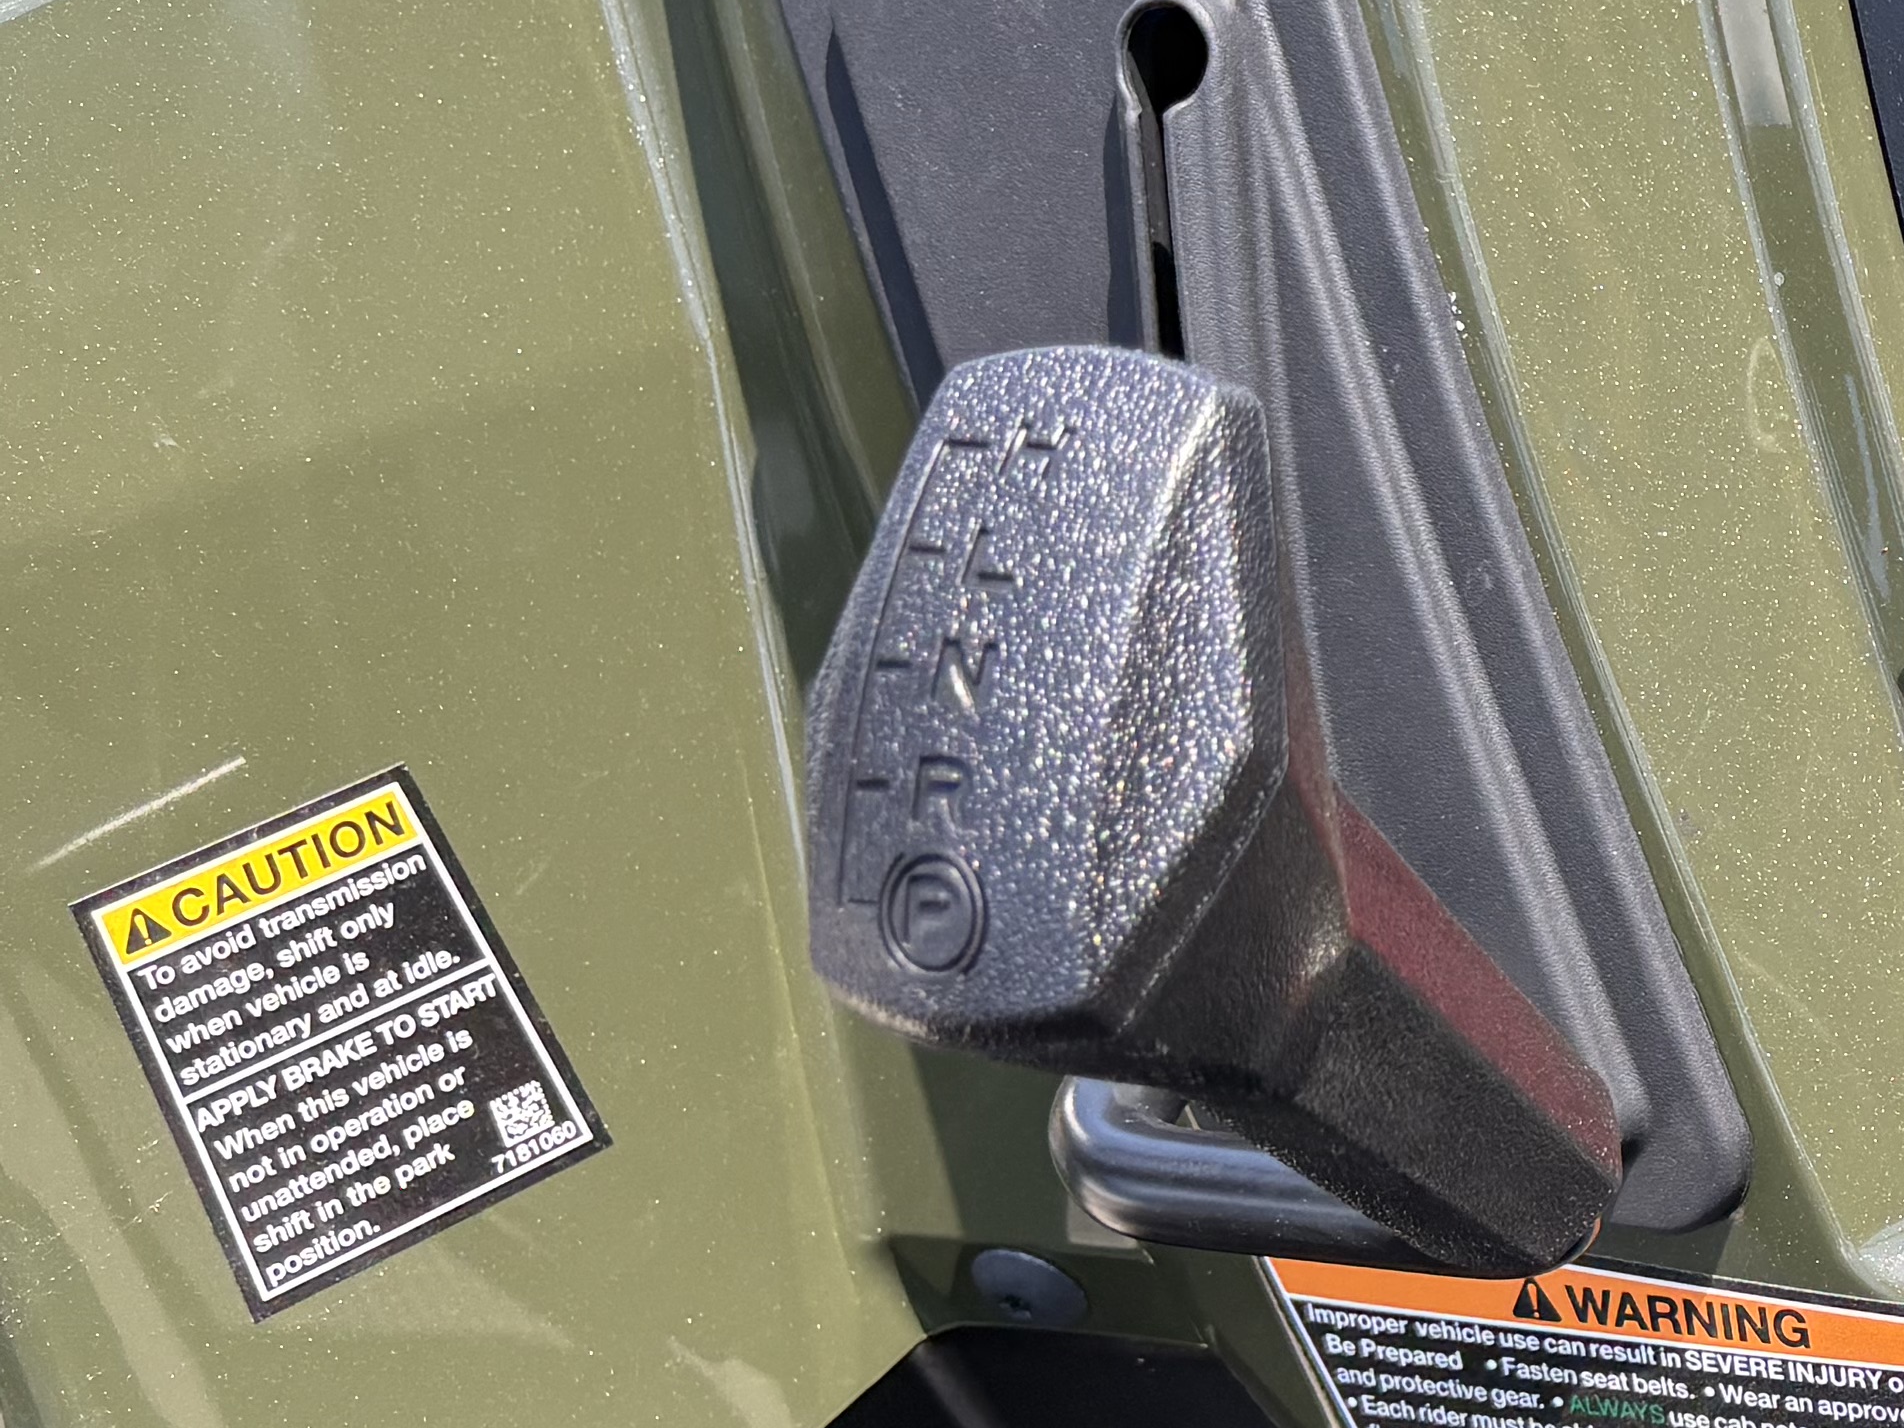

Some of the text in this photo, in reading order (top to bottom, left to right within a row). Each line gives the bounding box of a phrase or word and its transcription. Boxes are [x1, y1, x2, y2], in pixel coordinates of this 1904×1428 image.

[171, 801, 406, 927] CAUTION
[902, 874, 952, 943] P
[138, 855, 426, 990] To avoid transmission
[153, 903, 393, 1022] damage, shift only
[165, 952, 369, 1053] when vehicle is
[180, 950, 460, 1085] stationary and at idle.
[195, 974, 499, 1133] APPLY BRAKE TO START
[212, 1030, 473, 1160] When this vehicle is
[227, 1066, 467, 1193] not in operation or
[492, 1120, 577, 1174] 7181060
[239, 1100, 474, 1222] unattended, place
[252, 1143, 455, 1252] shift in the park
[267, 1219, 380, 1287] position.
[1307, 1303, 1409, 1334] Improper
[1415, 1319, 1496, 1345] vehicle
[1499, 1332, 1540, 1351] use
[1543, 1338, 1586, 1356] can
[1589, 1340, 1658, 1365] result
[1660, 1348, 1683, 1368] in
[1685, 1350, 1785, 1380] SEVERE
[1788, 1361, 1884, 1390] INJURY
[1324, 1333, 1356, 1356] Be
[1360, 1340, 1463, 1370] Prepared
[1502, 1357, 1578, 1385] Fasten
[1580, 1371, 1630, 1391] seat
[1632, 1373, 1696, 1399] belts.
[1719, 1383, 1780, 1410] Wear
[1784, 1396, 1813, 1413] an
[1564, 1283, 1811, 1349] WARNING
